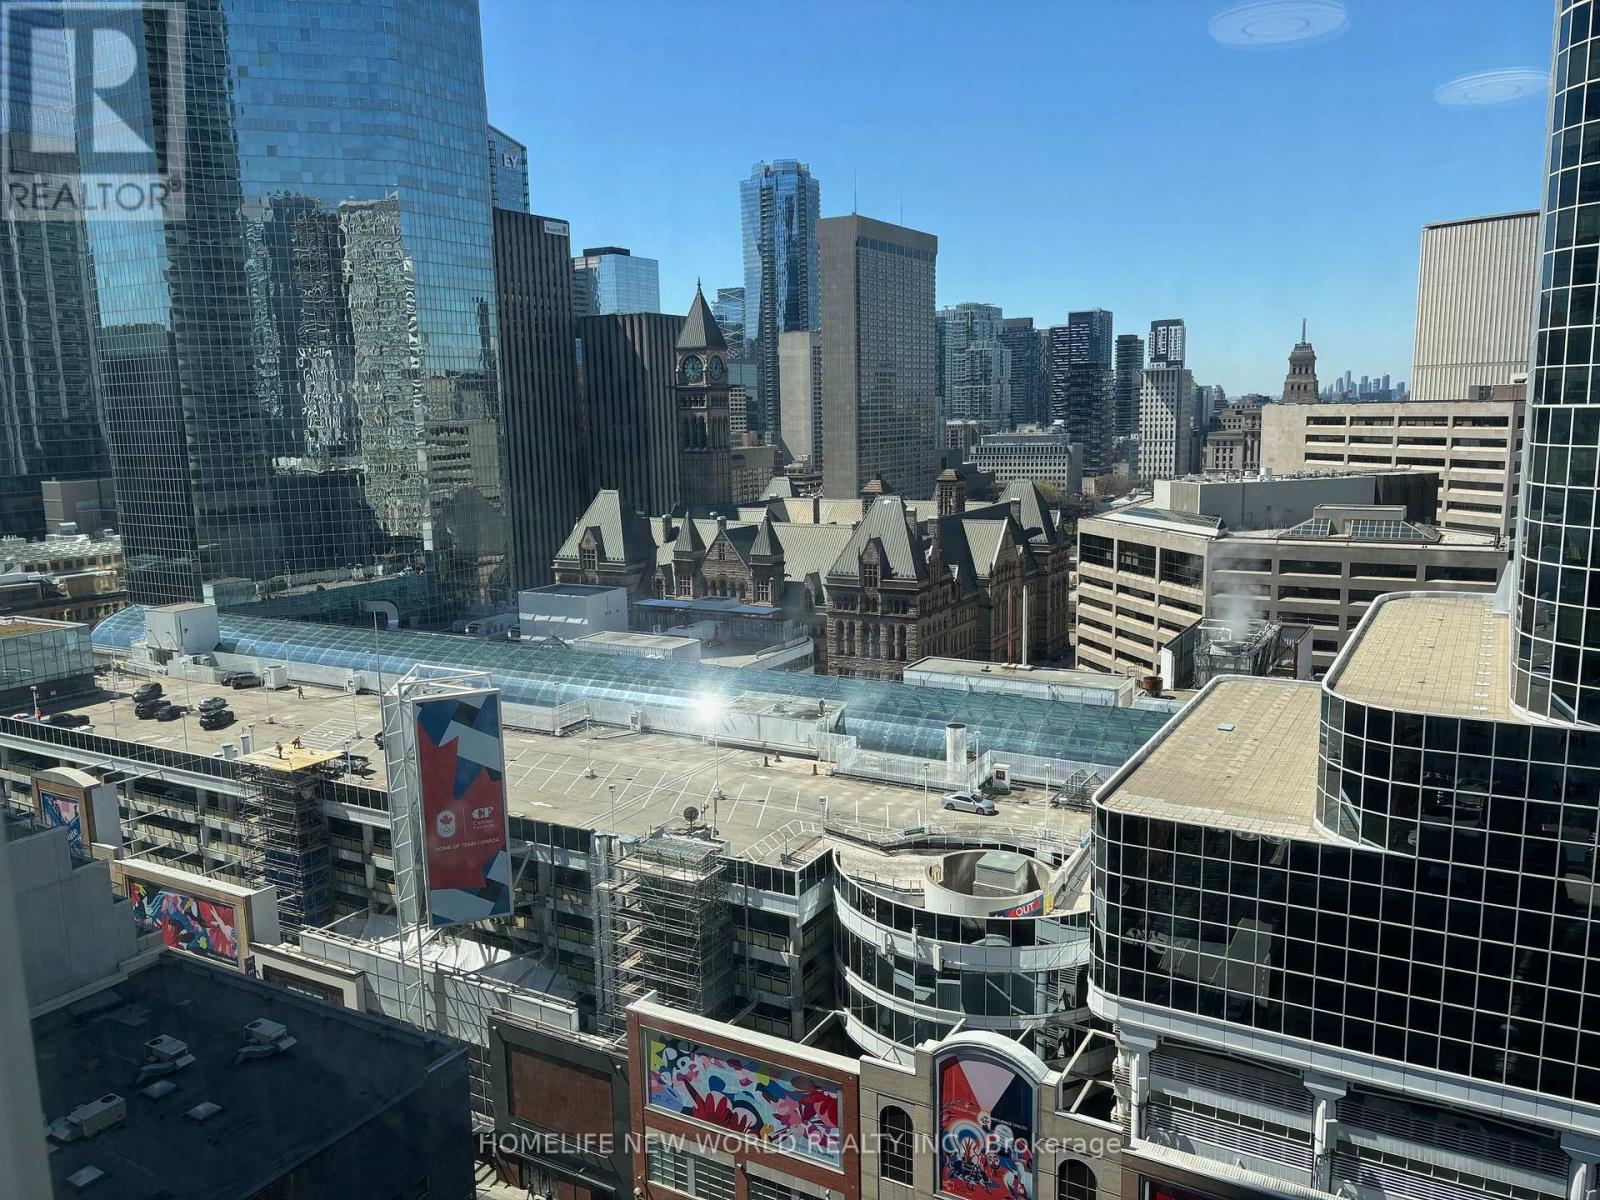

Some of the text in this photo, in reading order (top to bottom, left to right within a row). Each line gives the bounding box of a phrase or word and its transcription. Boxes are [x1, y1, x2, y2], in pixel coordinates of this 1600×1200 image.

[503, 153, 518, 168] EY
[472, 807, 494, 818] CF
[1015, 904, 1034, 916] OUT
